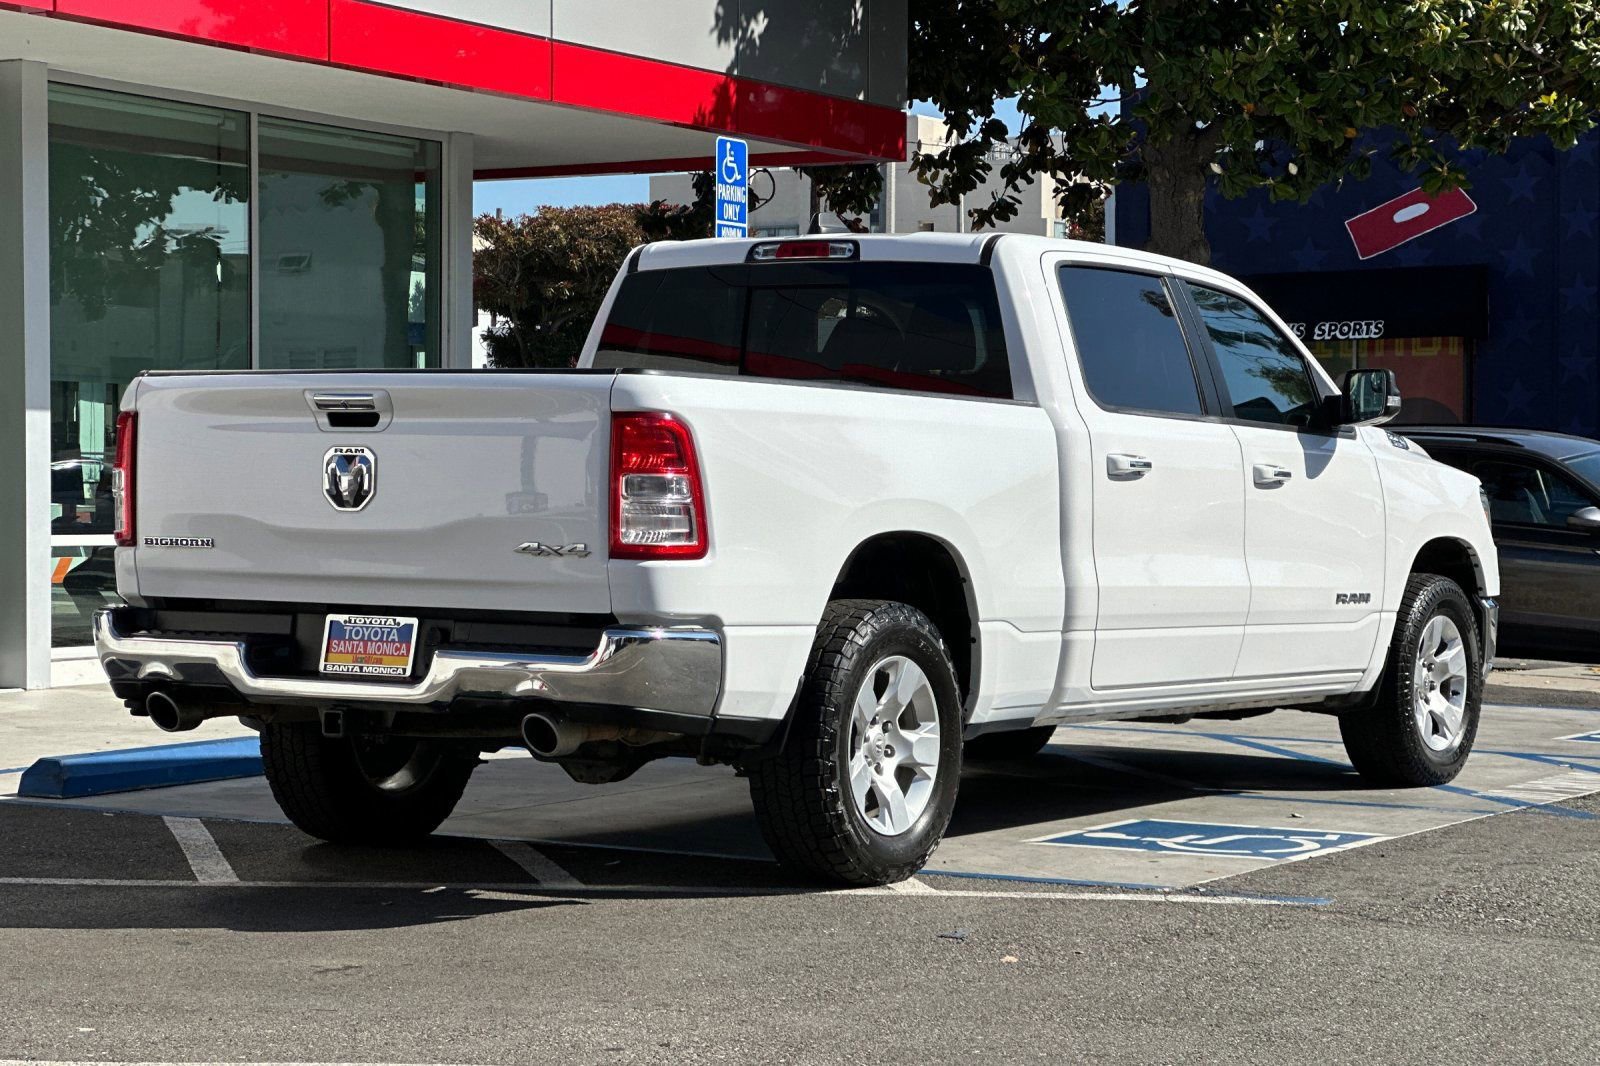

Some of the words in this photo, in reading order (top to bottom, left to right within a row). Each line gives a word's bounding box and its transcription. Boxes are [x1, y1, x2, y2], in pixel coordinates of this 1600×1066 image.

[718, 183, 746, 203] PARKING
[723, 203, 740, 221] ONLY
[1314, 320, 1385, 340] SPORTS
[143, 537, 214, 548] BIGHORN
[1335, 592, 1371, 605] RAM
[350, 617, 395, 626] TOYOTA
[344, 626, 399, 642] TOYOTA
[331, 640, 364, 653] SANTA
[366, 641, 407, 656] MONICA
[326, 664, 360, 673] SANTA
[362, 666, 404, 675] MONICA
